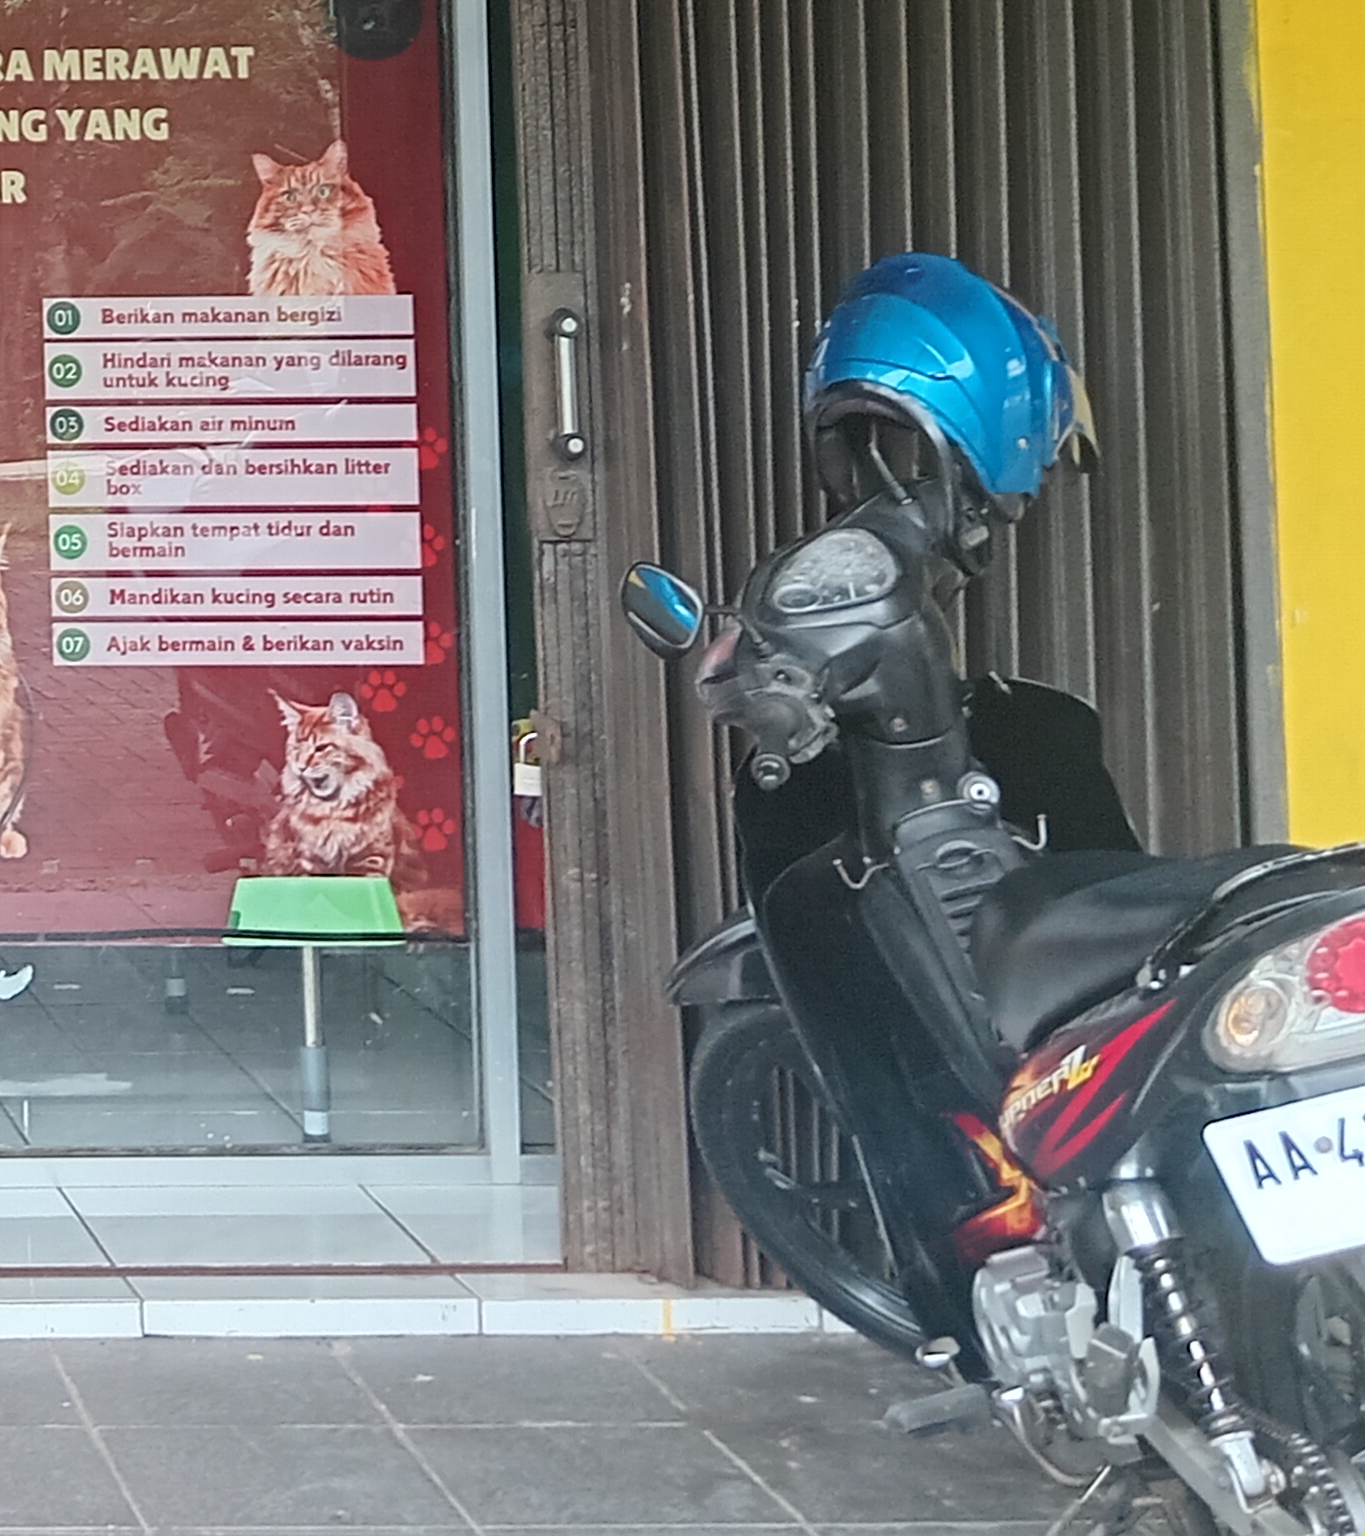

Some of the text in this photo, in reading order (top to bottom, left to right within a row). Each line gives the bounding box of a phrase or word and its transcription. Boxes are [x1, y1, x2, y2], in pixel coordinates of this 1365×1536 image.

[43, 46, 254, 81] MERAWAT
[55, 107, 169, 142] YANG
[53, 306, 342, 327] 01 Berikan makanan bergizi
[52, 348, 407, 380] 02 Hindari makanan yang dilarang
[103, 372, 230, 391] untuk kucing
[104, 416, 193, 433] Sediakan
[200, 416, 223, 432] air
[230, 416, 296, 432] minum
[56, 459, 391, 487] 04 Sediakan dan bersihkan litter
[107, 479, 142, 496] box
[57, 520, 356, 552] 05 Siapkan tempat tidur dan
[108, 542, 186, 558] bermain
[59, 588, 395, 608] 06 Mandikan kucing secara rutin
[61, 634, 405, 655] 07 Ajak bermain & berikan vaksin
[1243, 1131, 1319, 1190] AA
